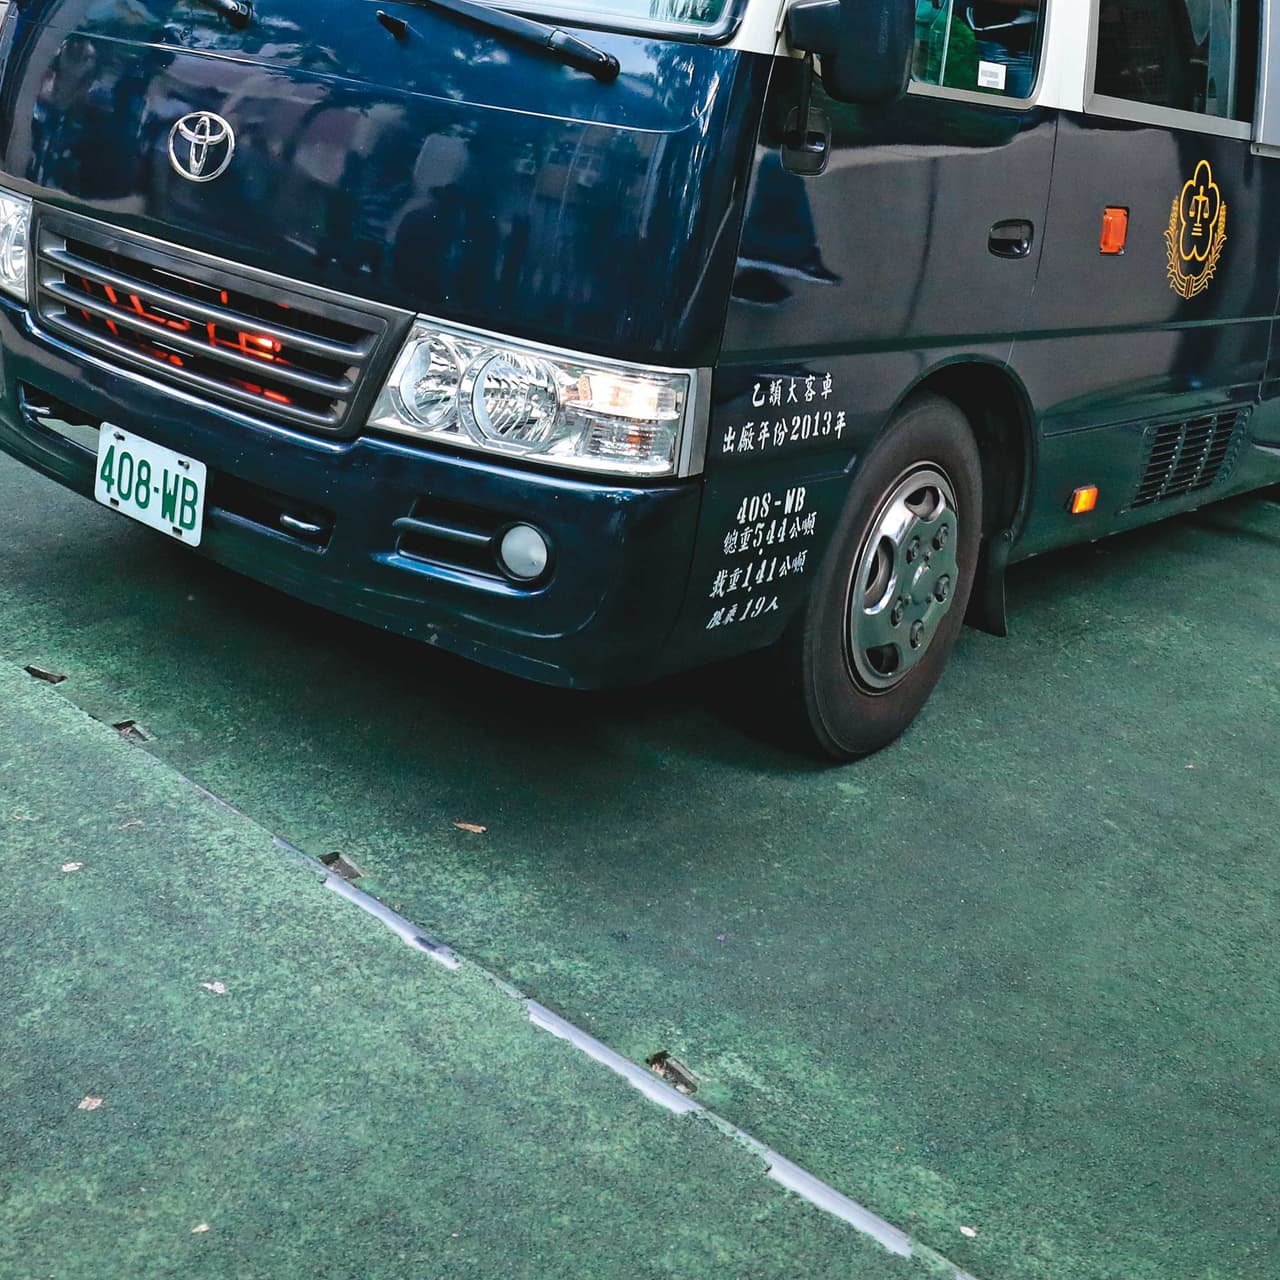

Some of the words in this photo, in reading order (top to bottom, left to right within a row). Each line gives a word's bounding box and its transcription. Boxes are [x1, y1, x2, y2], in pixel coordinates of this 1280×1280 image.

[752, 372, 833, 408] 乙類大客車
[722, 411, 846, 453] 出廠年份2013年
[100, 444, 198, 530] 408-WB
[736, 487, 806, 524] 408-WB
